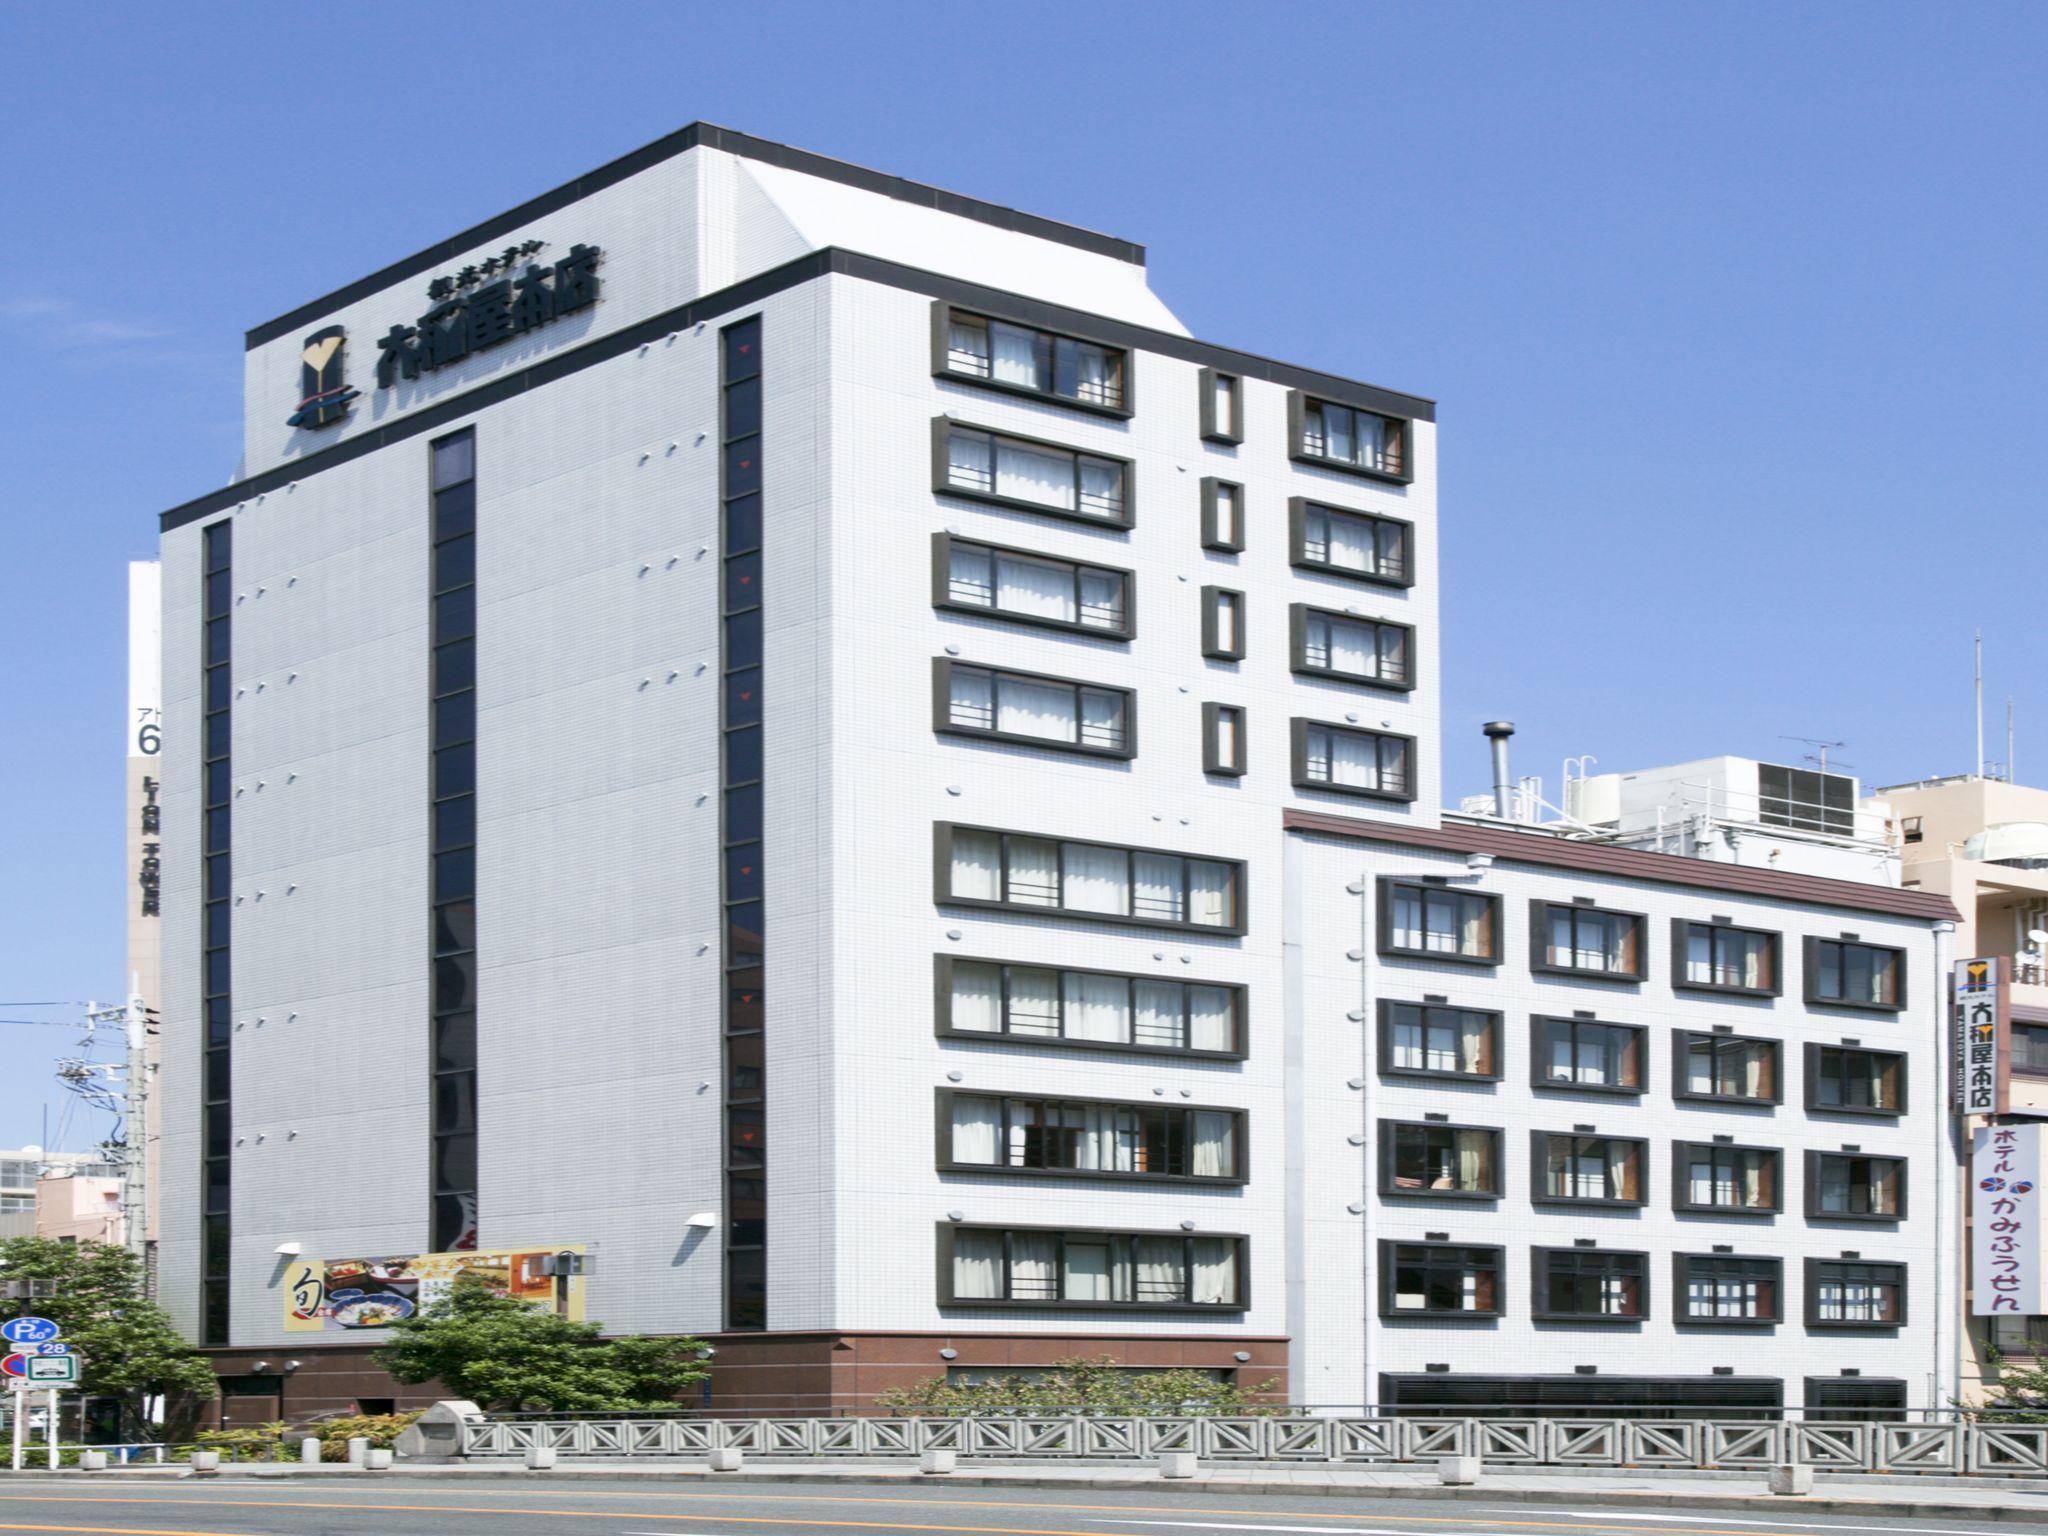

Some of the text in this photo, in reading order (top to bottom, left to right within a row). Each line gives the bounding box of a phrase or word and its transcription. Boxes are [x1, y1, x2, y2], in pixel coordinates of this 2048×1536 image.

[1956, 1015, 1965, 1062] YAMATOYA
[1990, 1130, 2022, 1311] ホテル かみふうせん
[42, 1343, 66, 1354] 28
